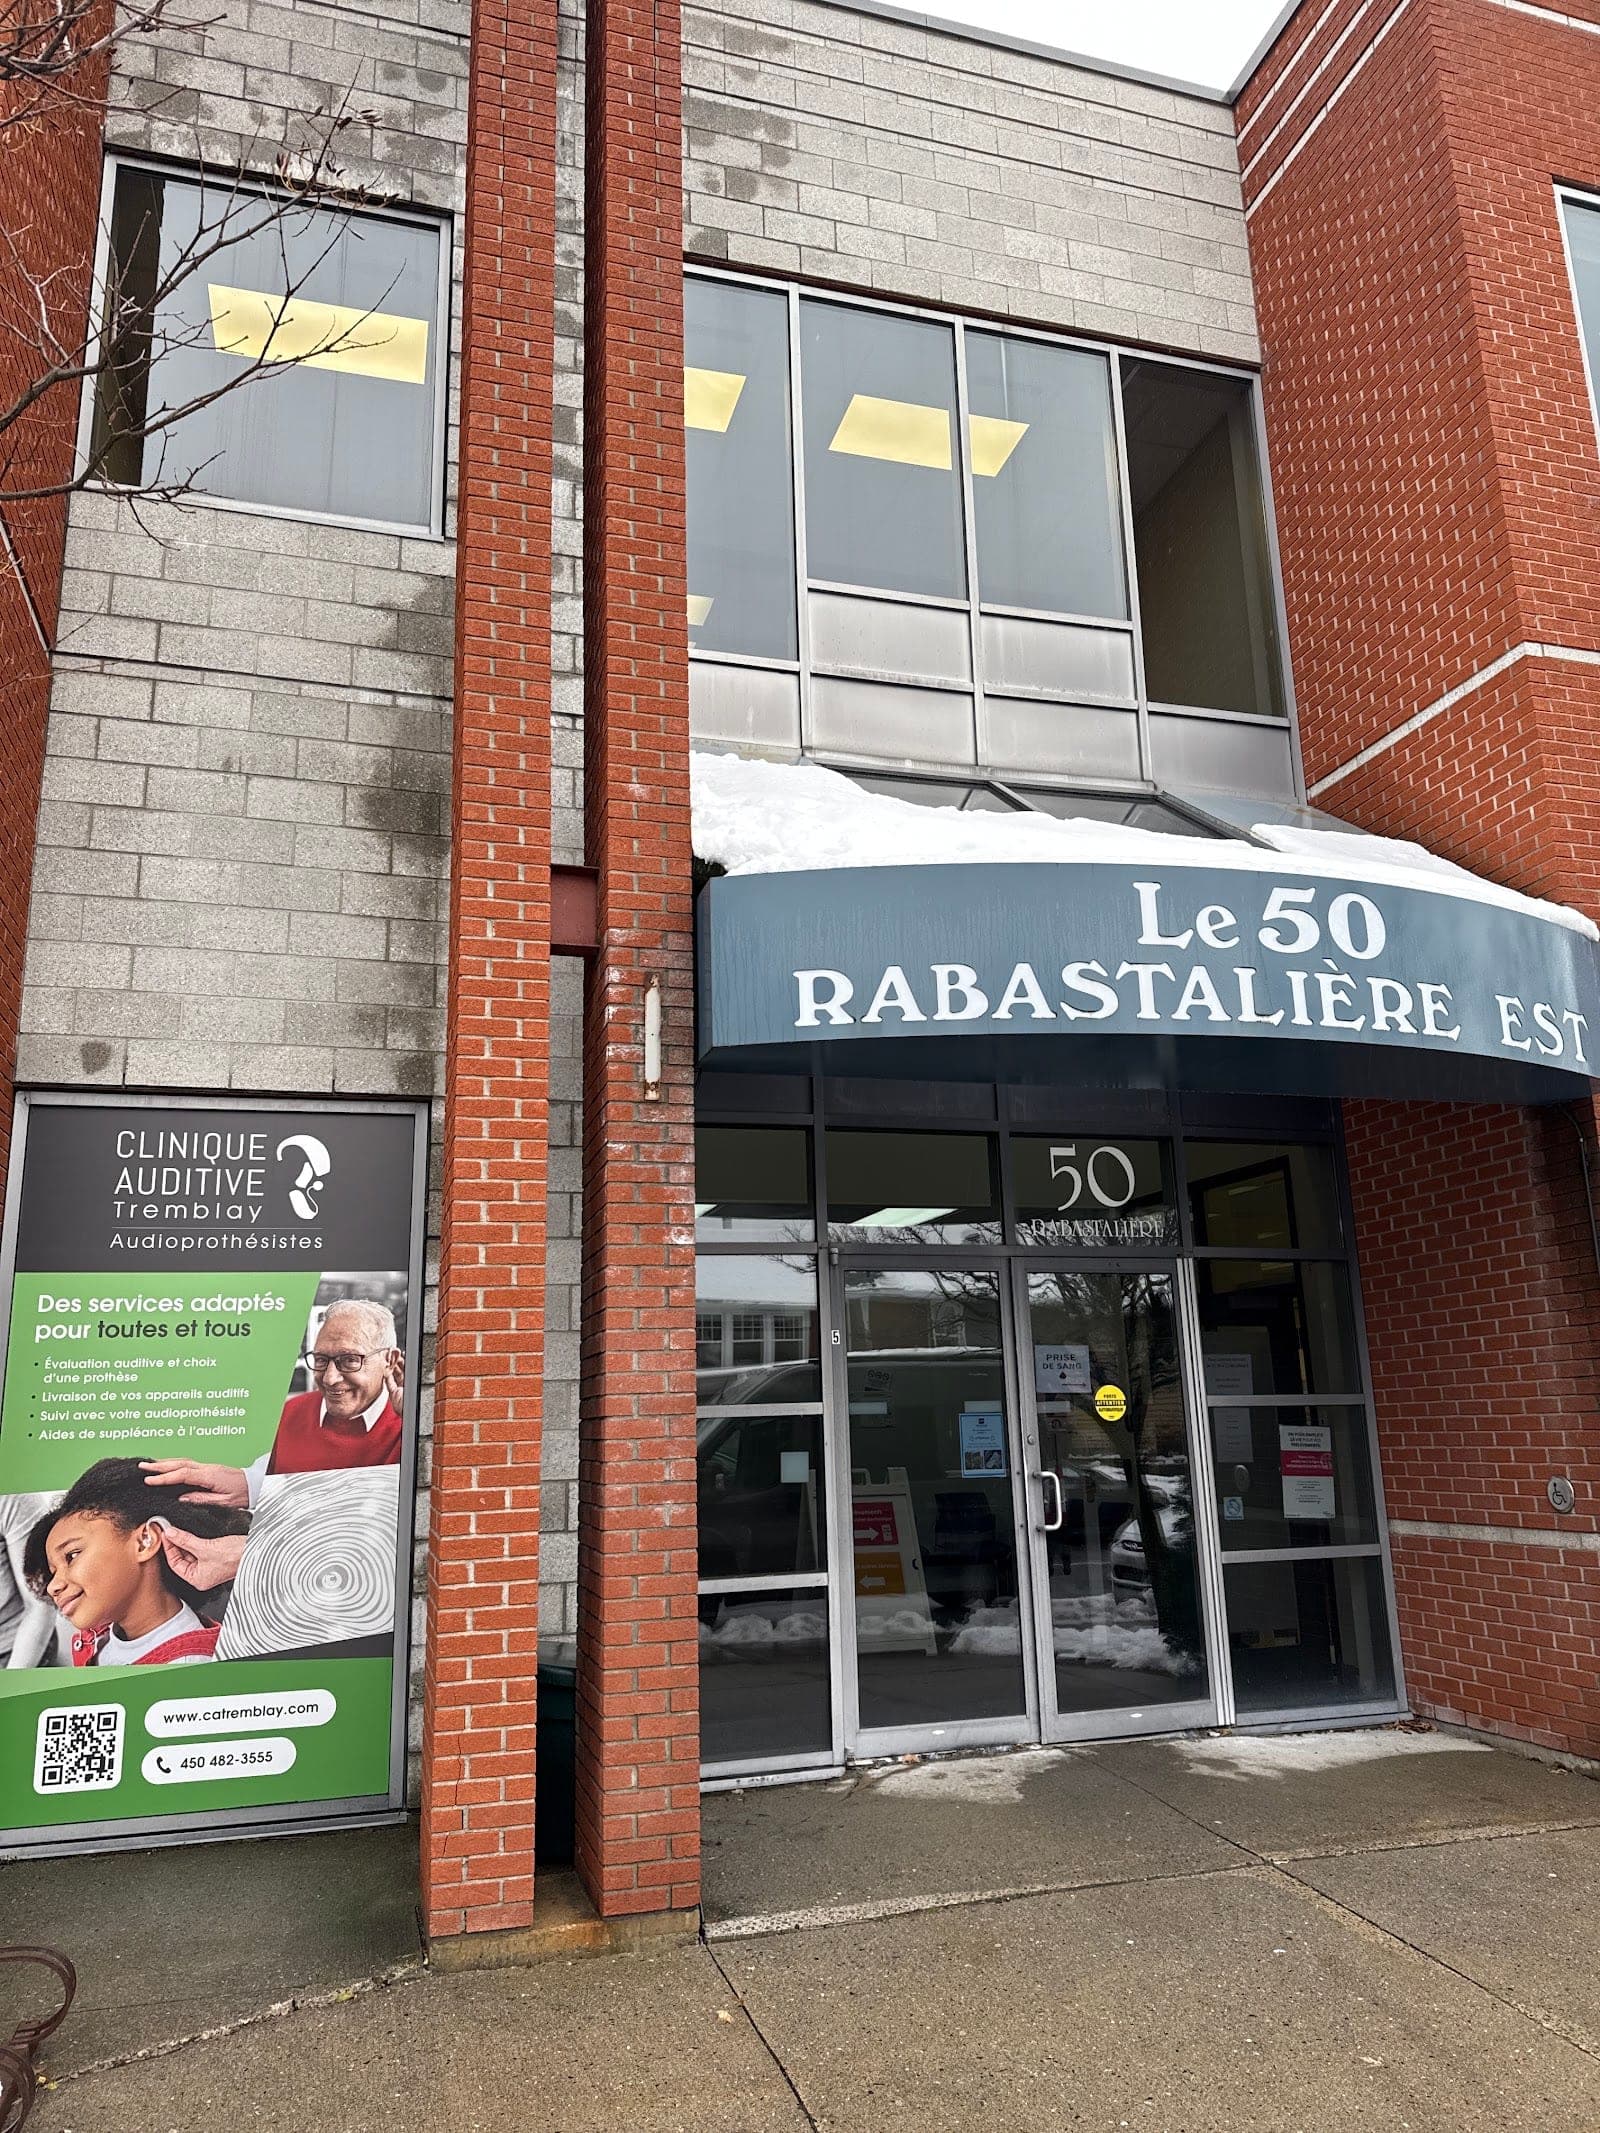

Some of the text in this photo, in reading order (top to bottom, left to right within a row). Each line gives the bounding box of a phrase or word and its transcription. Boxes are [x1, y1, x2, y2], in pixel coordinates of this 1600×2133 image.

[1131, 880, 1387, 960] Le 50
[792, 957, 1591, 1063] RABASTALIÈRE EST
[116, 1130, 268, 1165] CLINIQUE
[113, 1166, 266, 1197] AUDITIVE
[1049, 1143, 1136, 1212] 50
[113, 1201, 263, 1224] Tremblay
[109, 1233, 323, 1252] Audioprothésistes
[37, 1291, 286, 1315] Des services adaptés
[34, 1319, 251, 1343] pour toutes et tous
[833, 1330, 839, 1344] 5
[44, 1356, 217, 1370] Évaluation auditive et choix
[1046, 1353, 1077, 1361] PRISE
[1056, 1362, 1082, 1370] SANG
[43, 1372, 138, 1385] d'une prothèse
[41, 1388, 250, 1403] Livraison de vos appareils auditifs
[40, 1407, 246, 1421] Suivi avec votre audioprothésiste
[38, 1425, 246, 1442] Aides de suppléance à l'audition
[163, 1703, 319, 1724] www.catremblay.com
[180, 1751, 273, 1770] 450 482-3555
